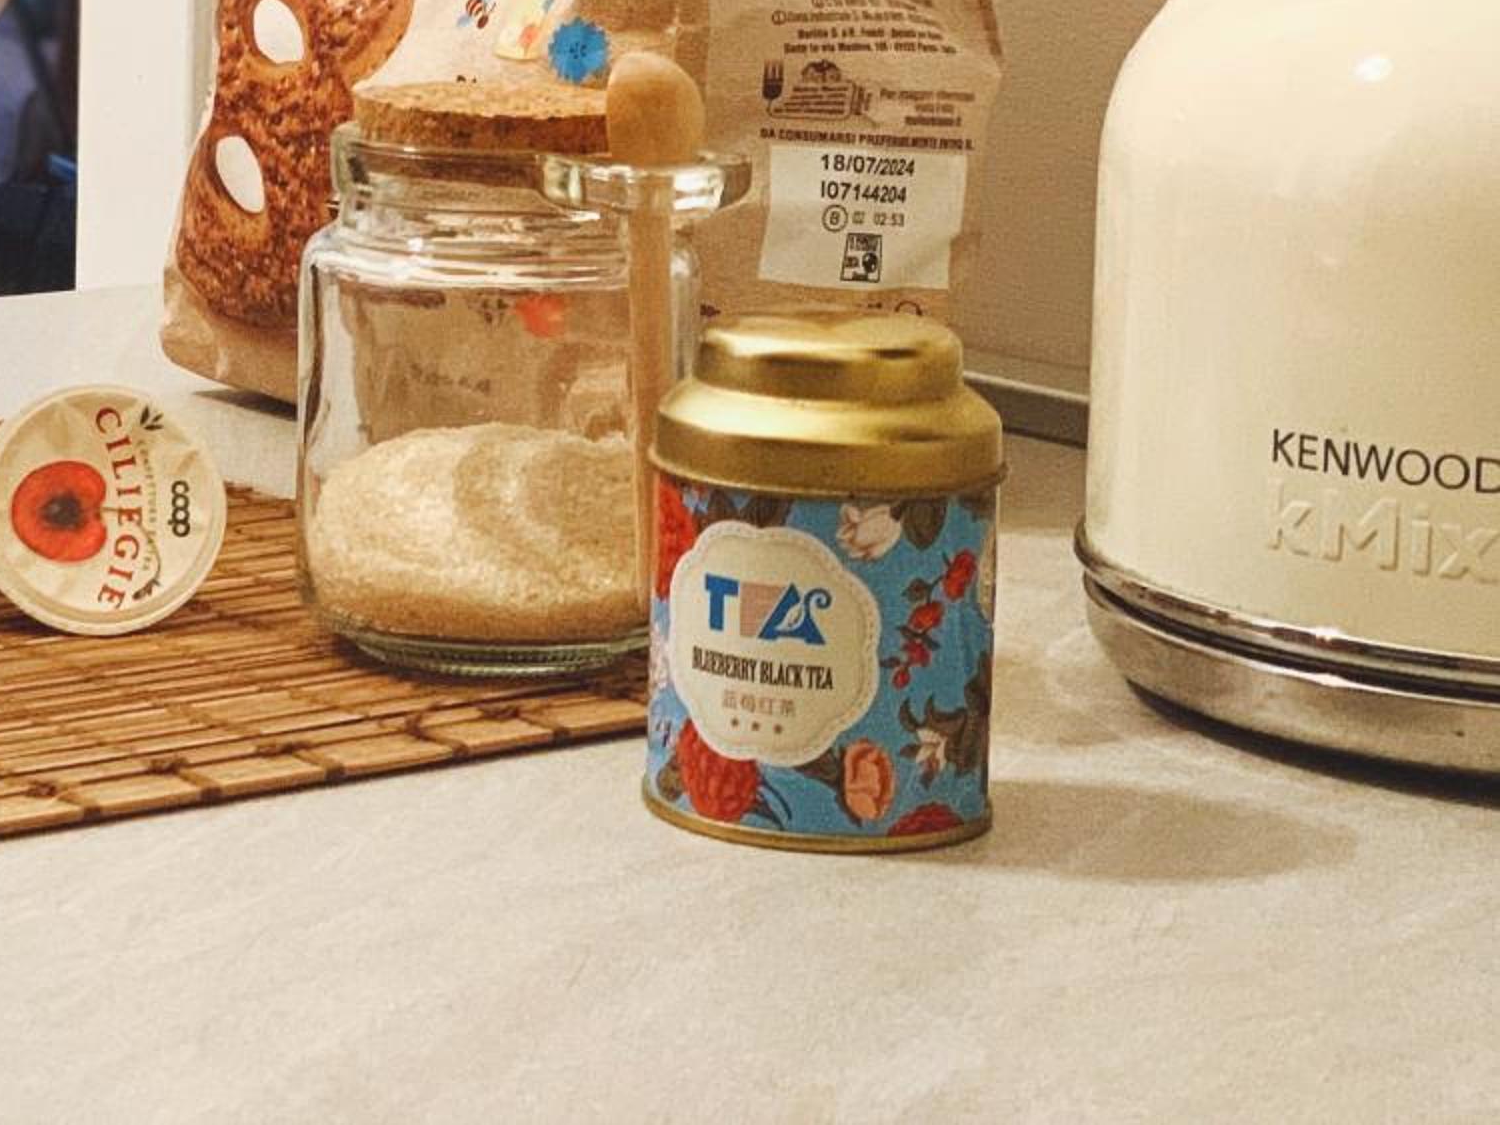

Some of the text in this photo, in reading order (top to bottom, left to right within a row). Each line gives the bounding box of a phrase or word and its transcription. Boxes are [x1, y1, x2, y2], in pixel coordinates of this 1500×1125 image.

[821, 154, 915, 176] 18/07/2024
[1271, 429, 1500, 494] KENWOOD
[95, 407, 142, 610] CILIEGIE
[168, 480, 190, 537] coop
[705, 573, 832, 646] TA
[691, 645, 834, 691] BLUEBERRY BLACK TEA
